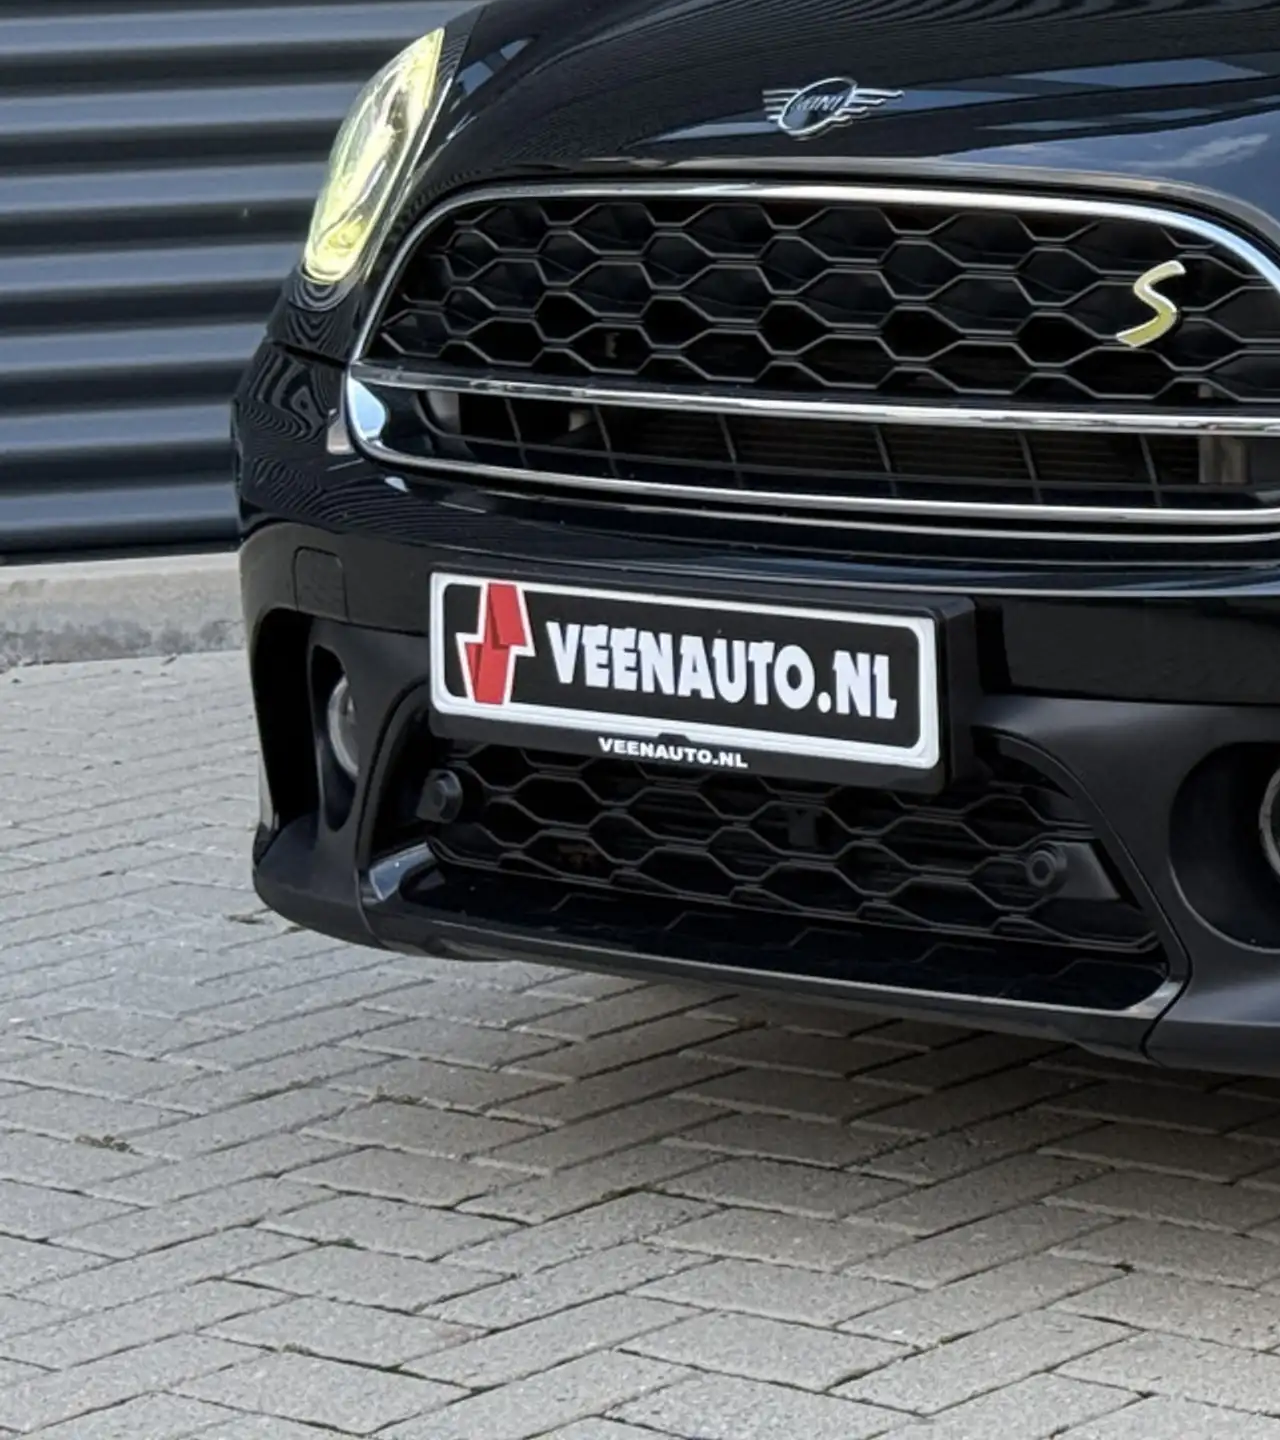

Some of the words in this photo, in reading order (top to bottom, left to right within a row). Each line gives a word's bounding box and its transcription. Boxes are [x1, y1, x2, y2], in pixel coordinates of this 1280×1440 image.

[1115, 258, 1186, 348] S
[545, 620, 898, 720] VEENAUTO.NL
[598, 736, 748, 769] VEENAUTO.NL
